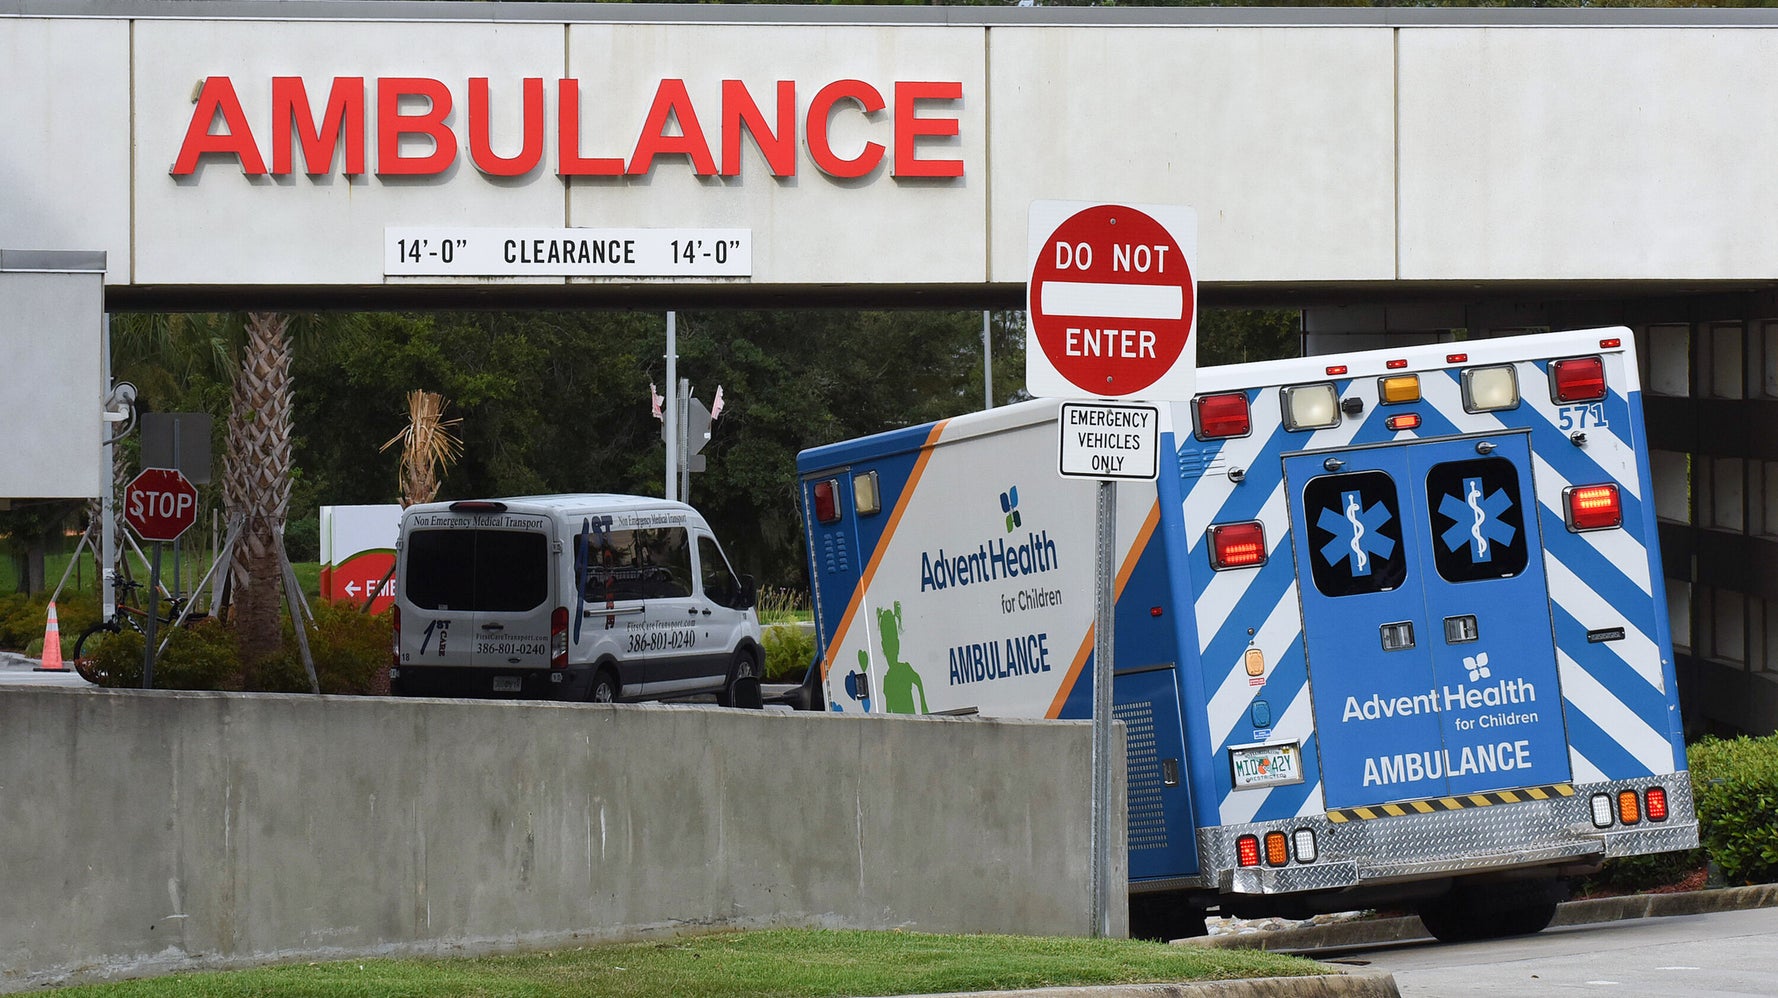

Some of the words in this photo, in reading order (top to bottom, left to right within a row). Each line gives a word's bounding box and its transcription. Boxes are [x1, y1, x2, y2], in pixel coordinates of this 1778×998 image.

[170, 76, 964, 178] AMBULANCE
[503, 239, 636, 264] CLEARANCE
[1055, 241, 1093, 271] DO
[1113, 244, 1169, 273] NOT
[1066, 328, 1157, 359] ENTER
[1070, 410, 1149, 428] EMERGENCY
[1558, 402, 1610, 431] 571
[1078, 432, 1140, 450] VEHICLES
[1091, 455, 1124, 472] ONLY
[129, 490, 193, 520] STOP
[413, 515, 430, 526] Non
[430, 516, 471, 529] Emergency
[472, 515, 503, 527] Medical
[504, 516, 544, 530] Transport
[1001, 594, 1016, 614] for
[1018, 589, 1063, 611] Children
[438, 630, 448, 657] CARE
[477, 643, 546, 655] 386-801-0240
[627, 630, 696, 653] 386-801-0240
[401, 653, 410, 662] 18
[949, 633, 1051, 686] AMBULANCE
[1455, 718, 1474, 731] for
[1479, 712, 1538, 729] Children
[1362, 740, 1533, 787] AMBULANCE
